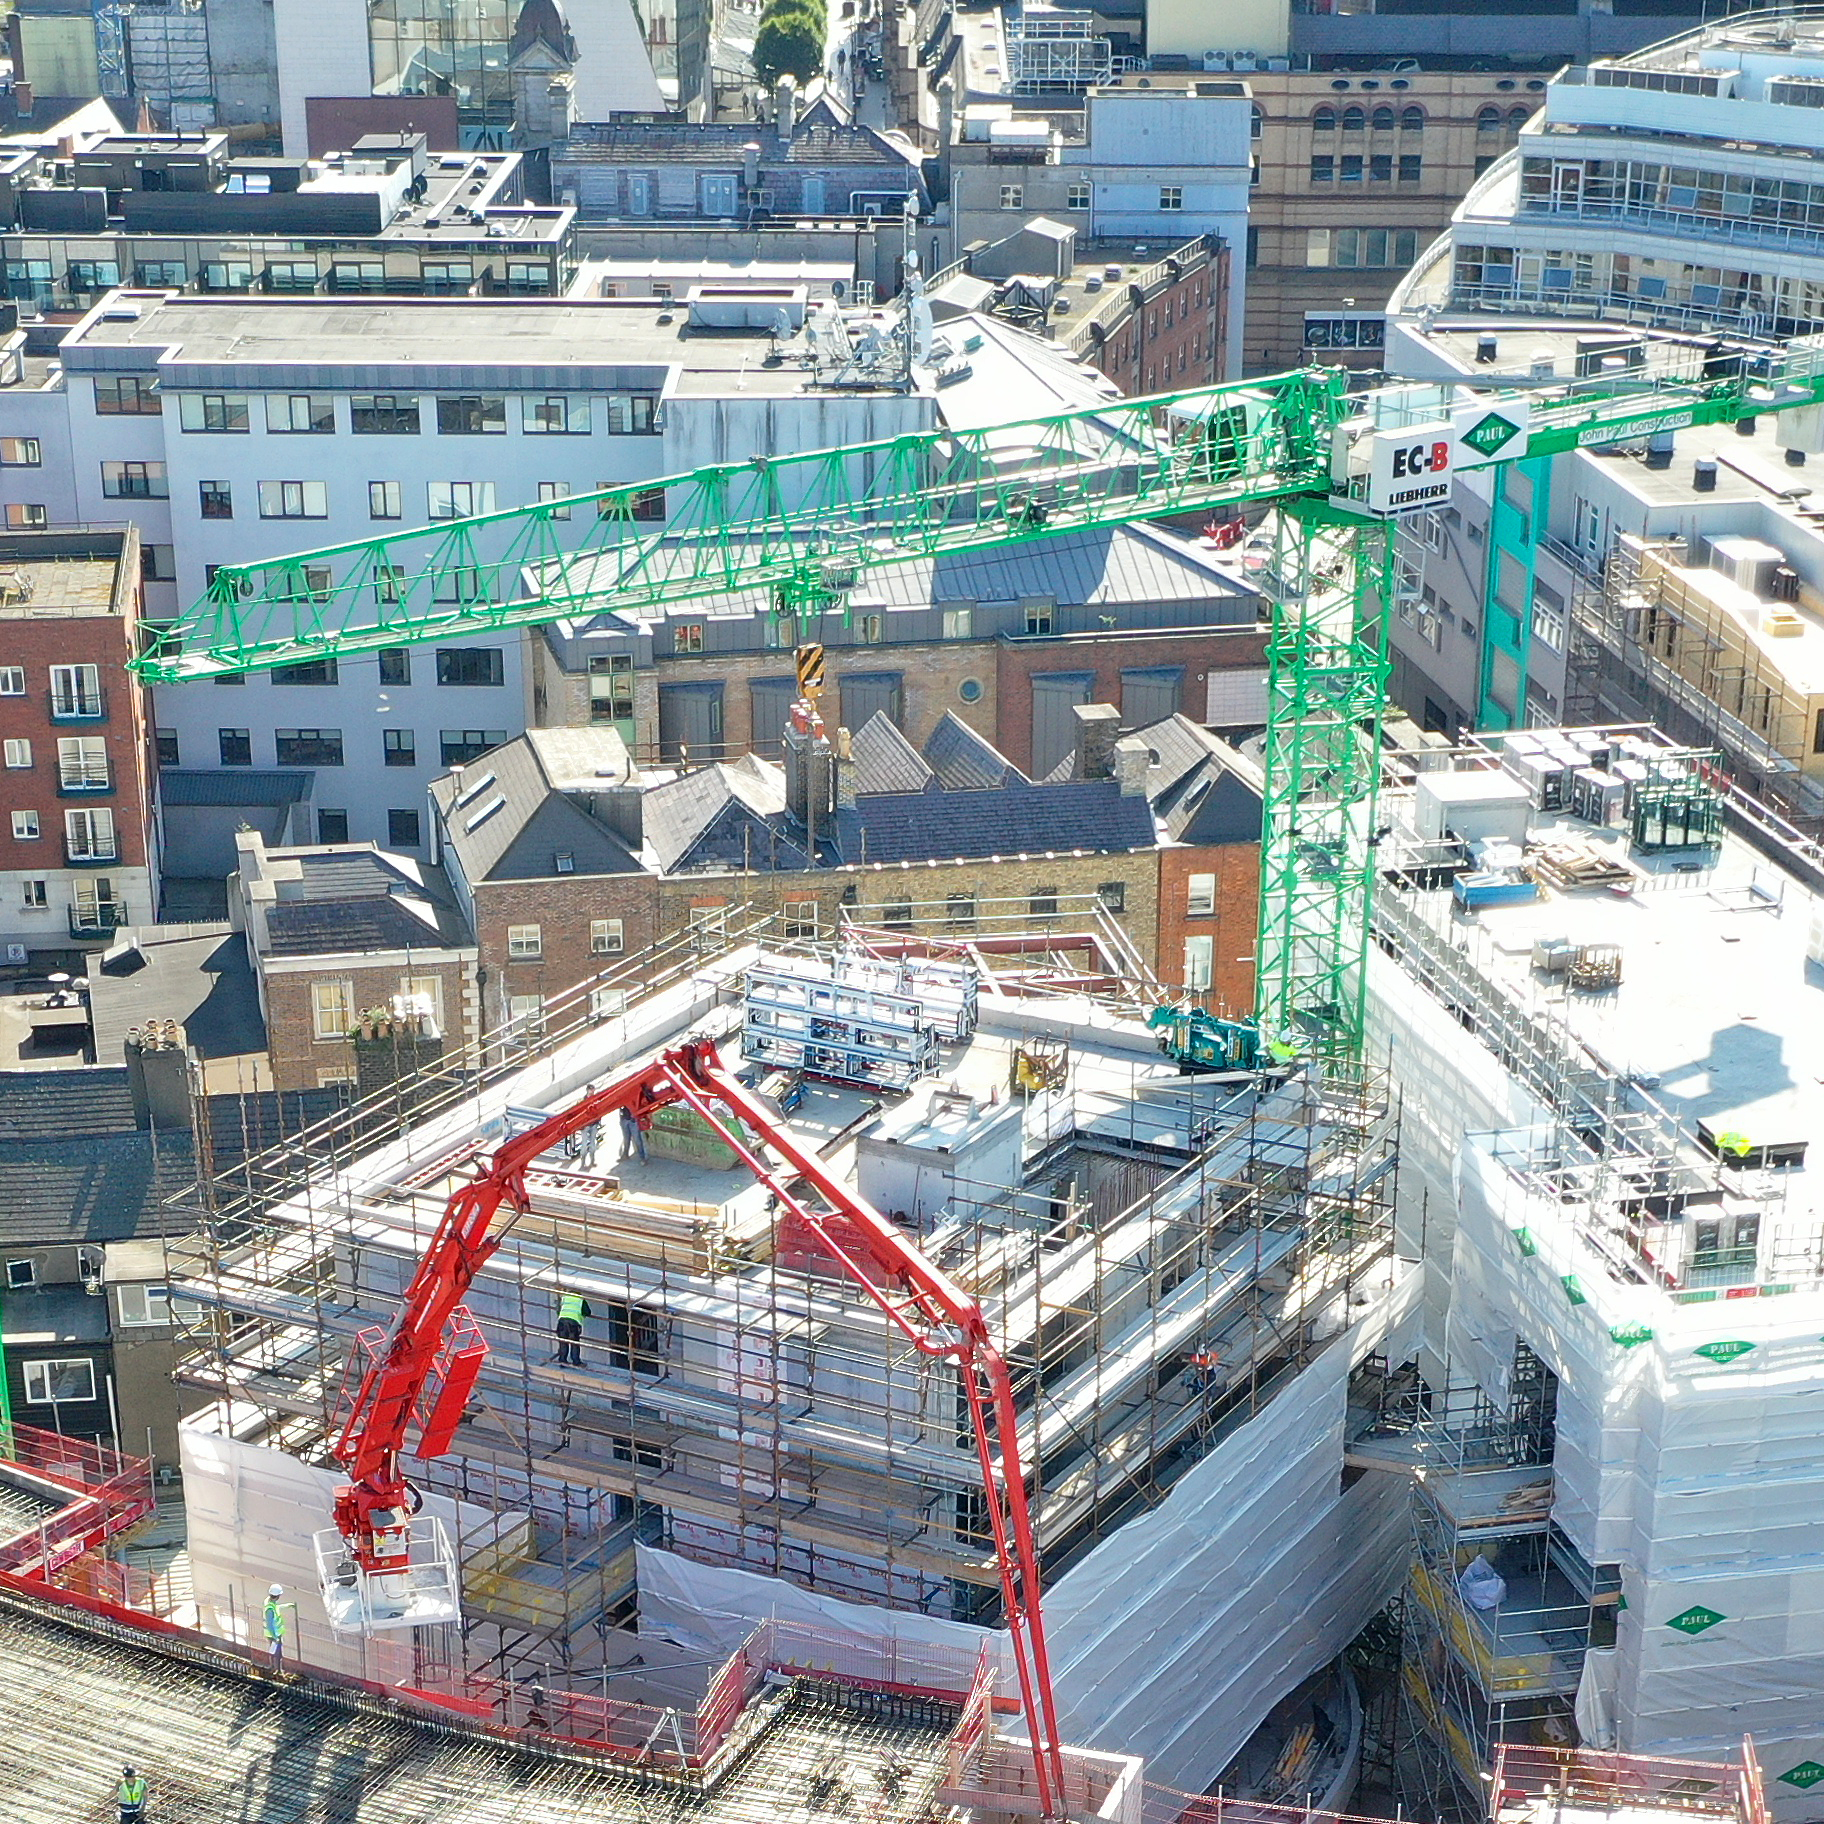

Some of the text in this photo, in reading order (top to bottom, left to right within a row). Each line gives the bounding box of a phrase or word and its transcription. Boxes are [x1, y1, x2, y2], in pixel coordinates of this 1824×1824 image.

[1476, 425, 1505, 443] PAUL
[1579, 427, 1604, 442] John
[1392, 442, 1449, 479] EC-B
[1389, 483, 1448, 506] LIEBHERR
[1710, 1344, 1740, 1354] PAUL
[1681, 1615, 1712, 1626] PAUL
